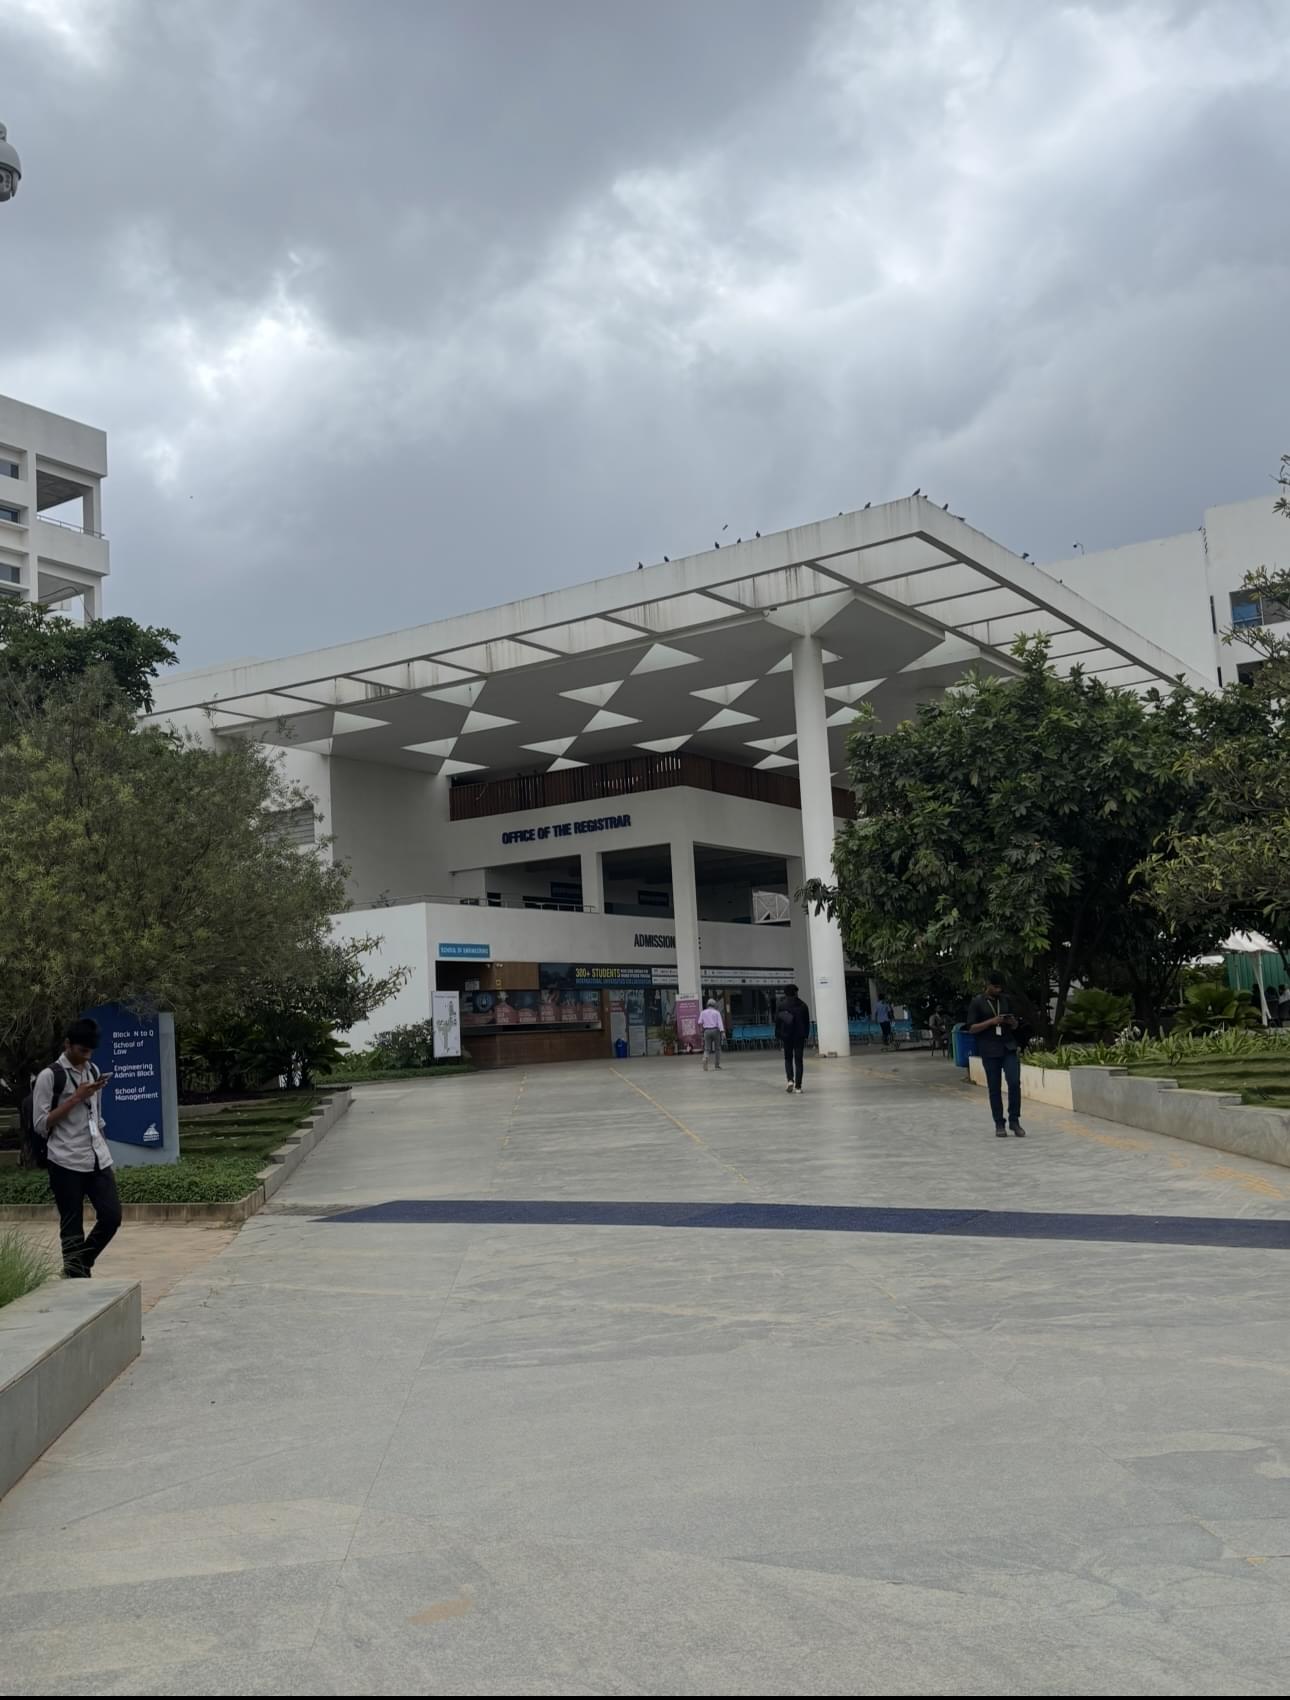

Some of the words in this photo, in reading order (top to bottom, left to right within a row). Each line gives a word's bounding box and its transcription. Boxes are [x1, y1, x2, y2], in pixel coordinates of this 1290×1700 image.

[502, 829, 535, 844] OFFICE
[537, 826, 551, 840] OF
[552, 823, 572, 837] THE
[573, 814, 632, 834] REGISTRAR
[592, 968, 621, 978] STUDENTS
[113, 1041, 135, 1049] School
[114, 1063, 153, 1072] Engineering
[114, 1071, 136, 1079] Admin
[115, 1087, 137, 1095] School
[115, 1092, 158, 1101] Management
